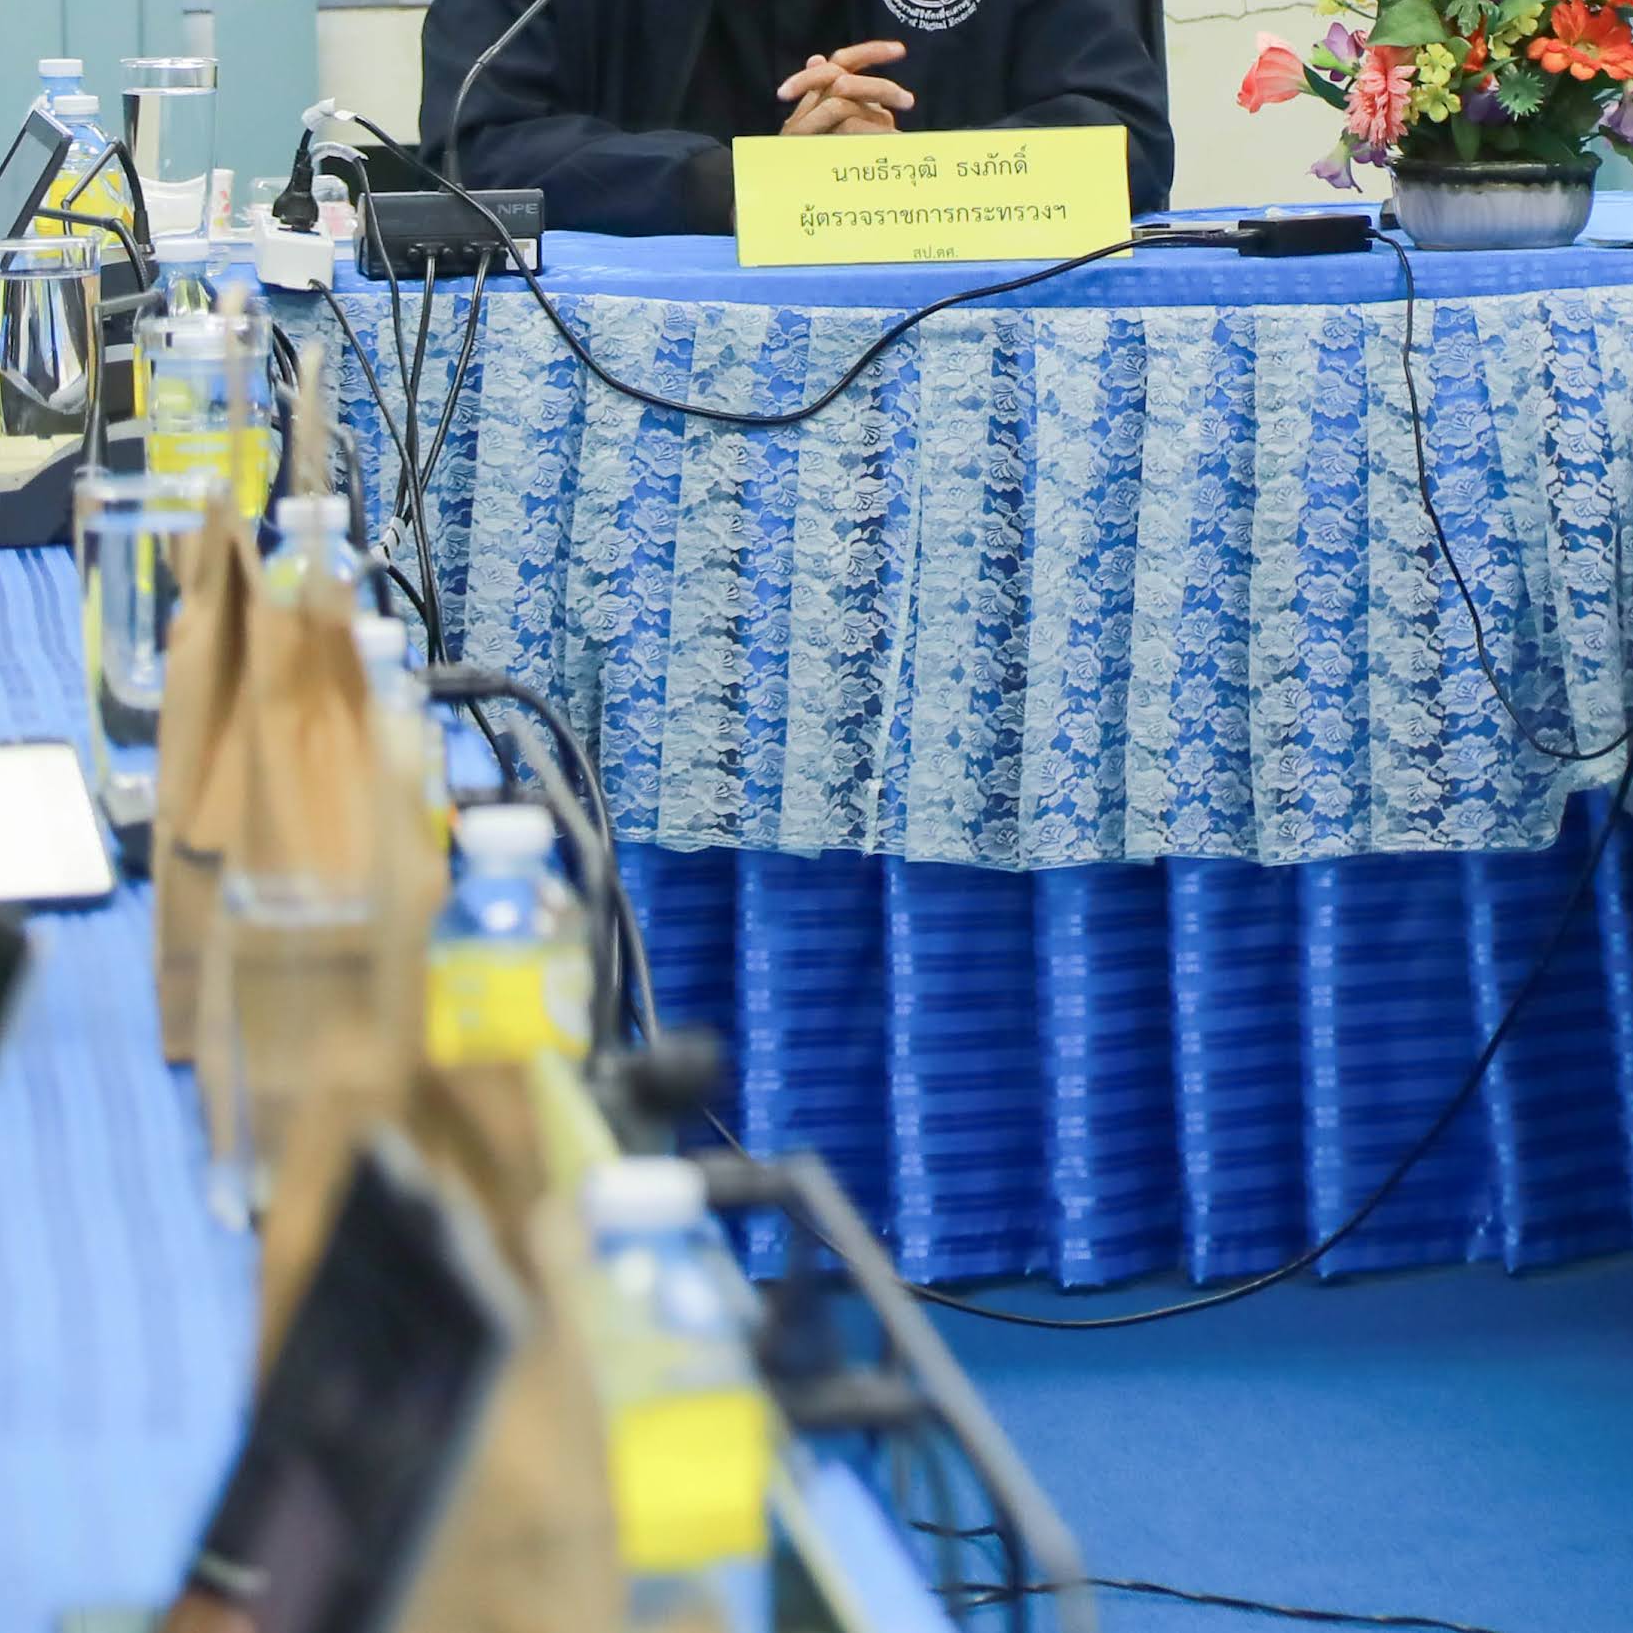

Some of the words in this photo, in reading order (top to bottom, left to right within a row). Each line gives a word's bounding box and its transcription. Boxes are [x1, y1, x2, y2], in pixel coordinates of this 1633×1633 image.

[918, 19, 947, 31] Digital
[831, 155, 938, 186] นายธีรวุฒิ
[956, 144, 1028, 178] ธงภักดิ์
[497, 203, 539, 214] NPE
[799, 203, 1067, 236] ผู้ตรวจราชการกระทรวงฯ
